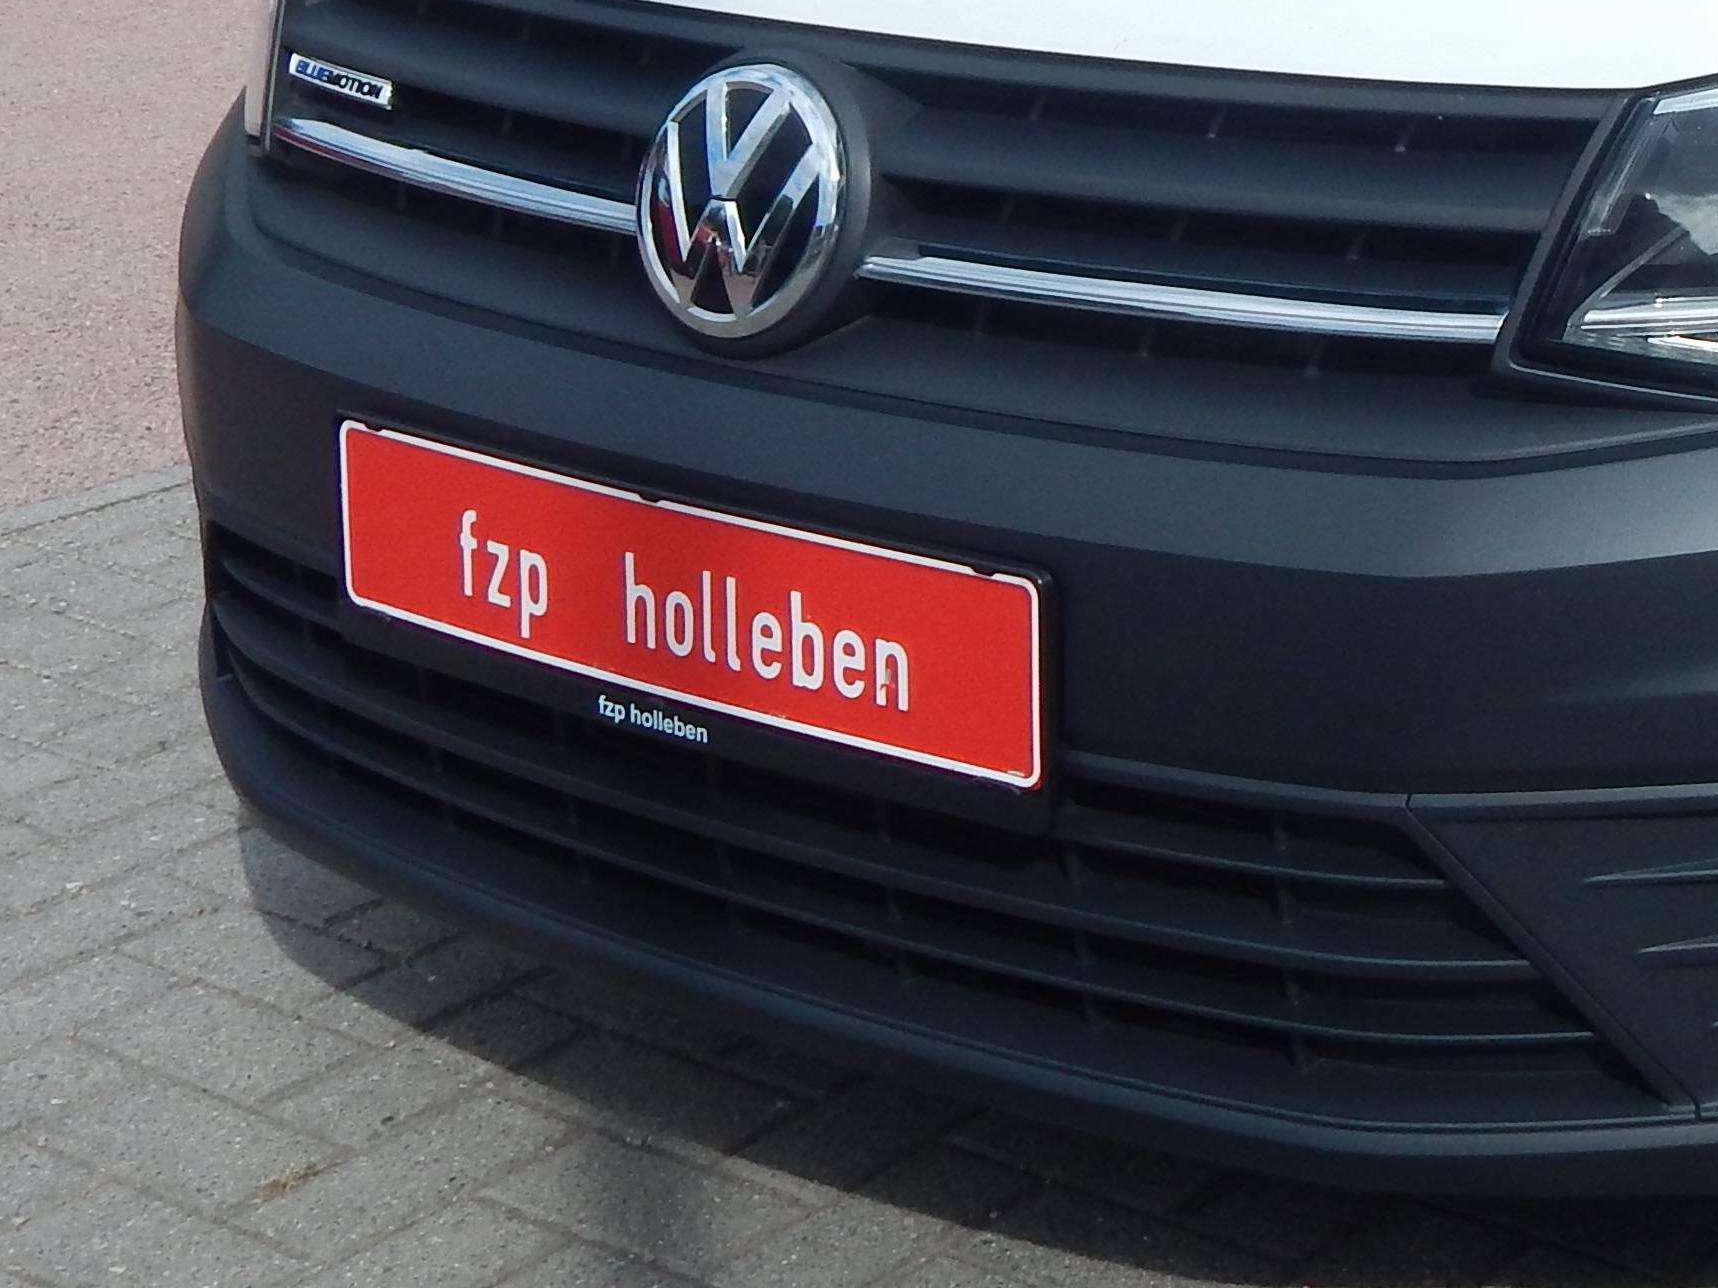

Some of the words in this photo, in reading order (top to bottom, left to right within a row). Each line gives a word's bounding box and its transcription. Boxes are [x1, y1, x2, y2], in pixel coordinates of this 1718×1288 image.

[459, 509, 549, 640] fzp
[624, 551, 910, 712] holleben
[598, 693, 626, 724] fzp
[629, 702, 708, 744] holleben
